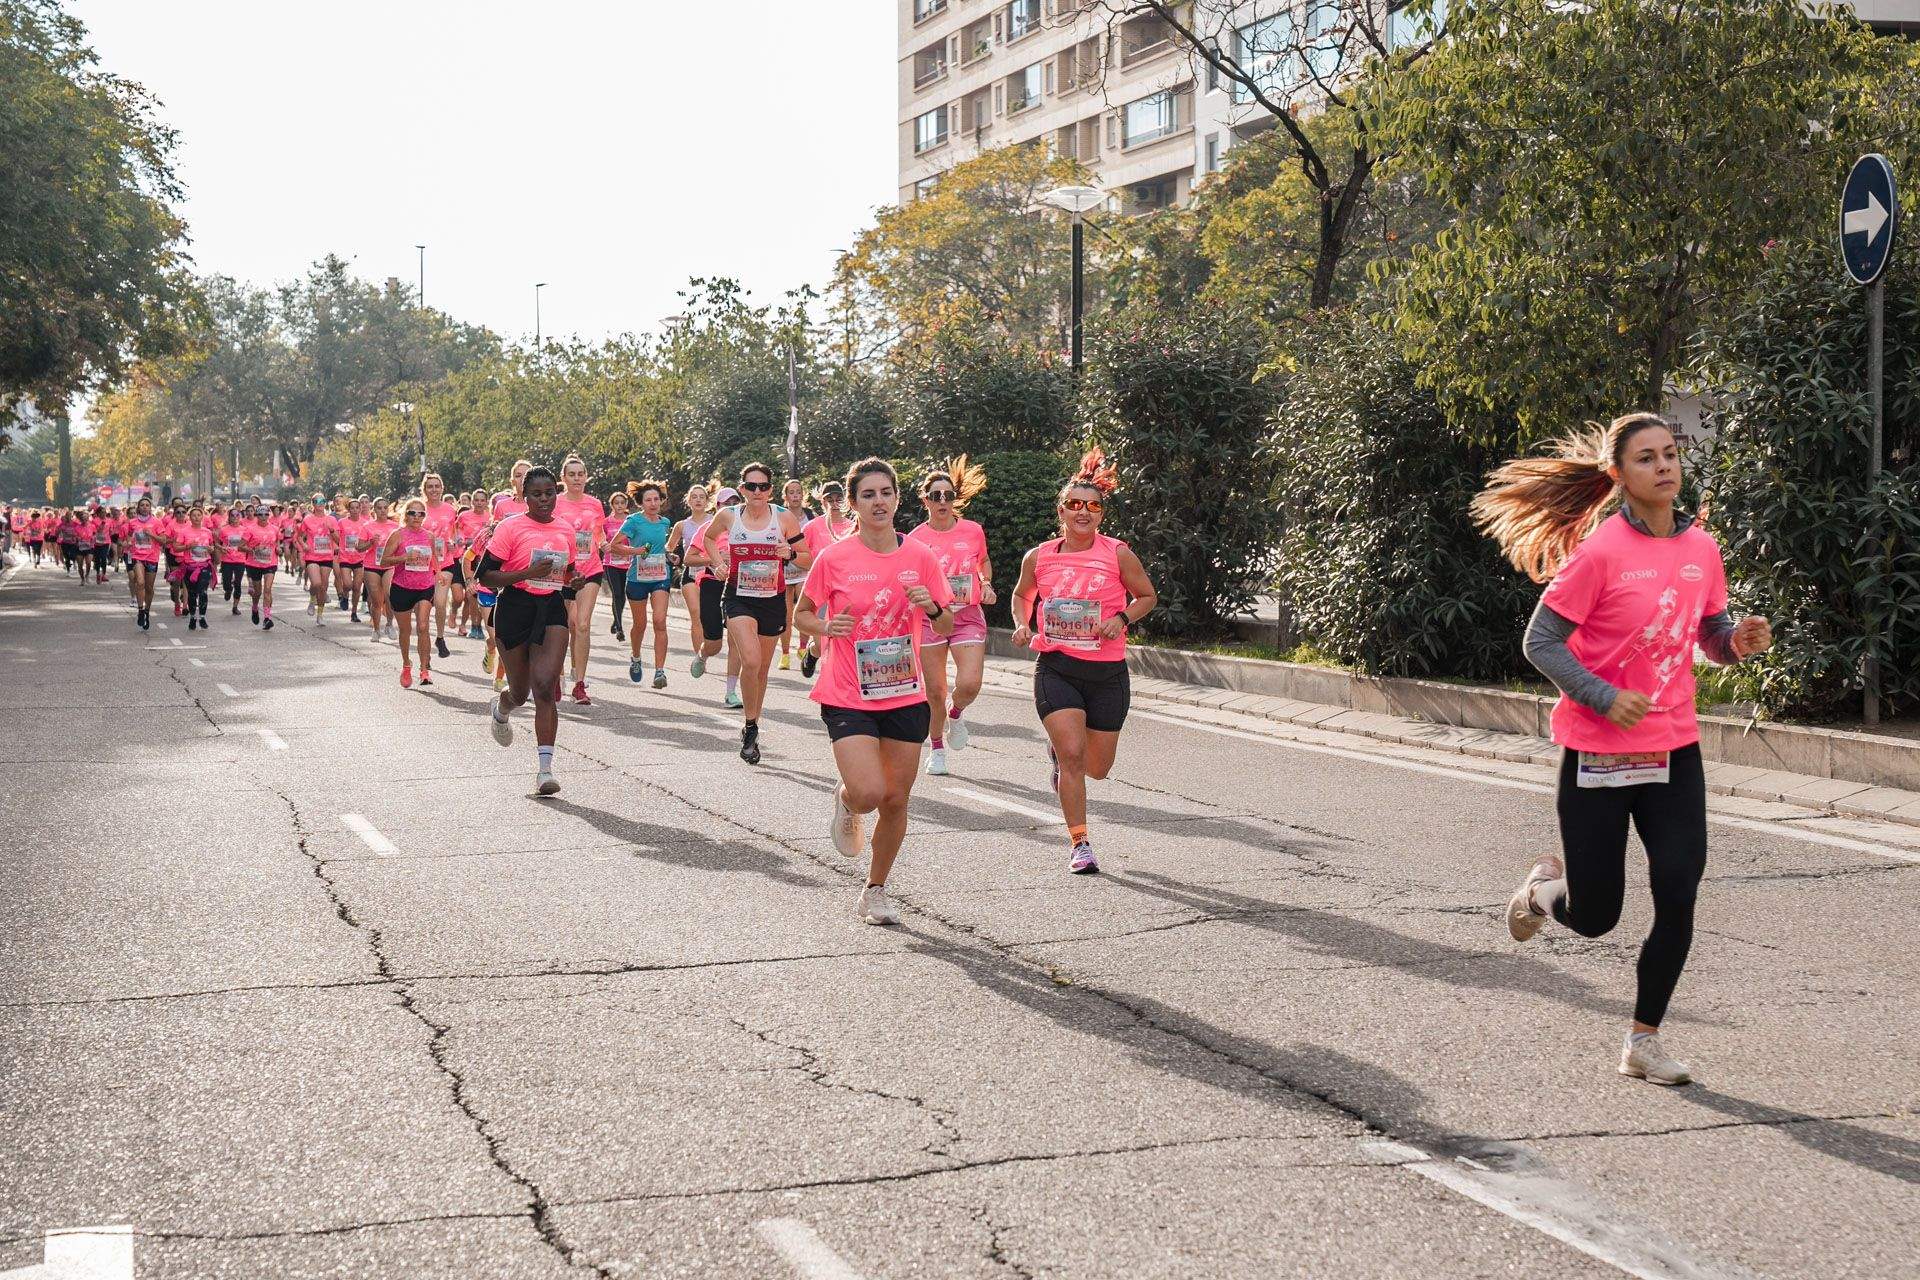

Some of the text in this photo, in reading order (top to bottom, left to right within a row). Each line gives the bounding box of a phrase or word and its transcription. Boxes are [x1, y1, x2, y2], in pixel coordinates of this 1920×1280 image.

[848, 573, 877, 582] OYSHO
[1620, 569, 1658, 581] OYSHO
[1060, 621, 1082, 630] 016
[880, 663, 903, 675] 016
